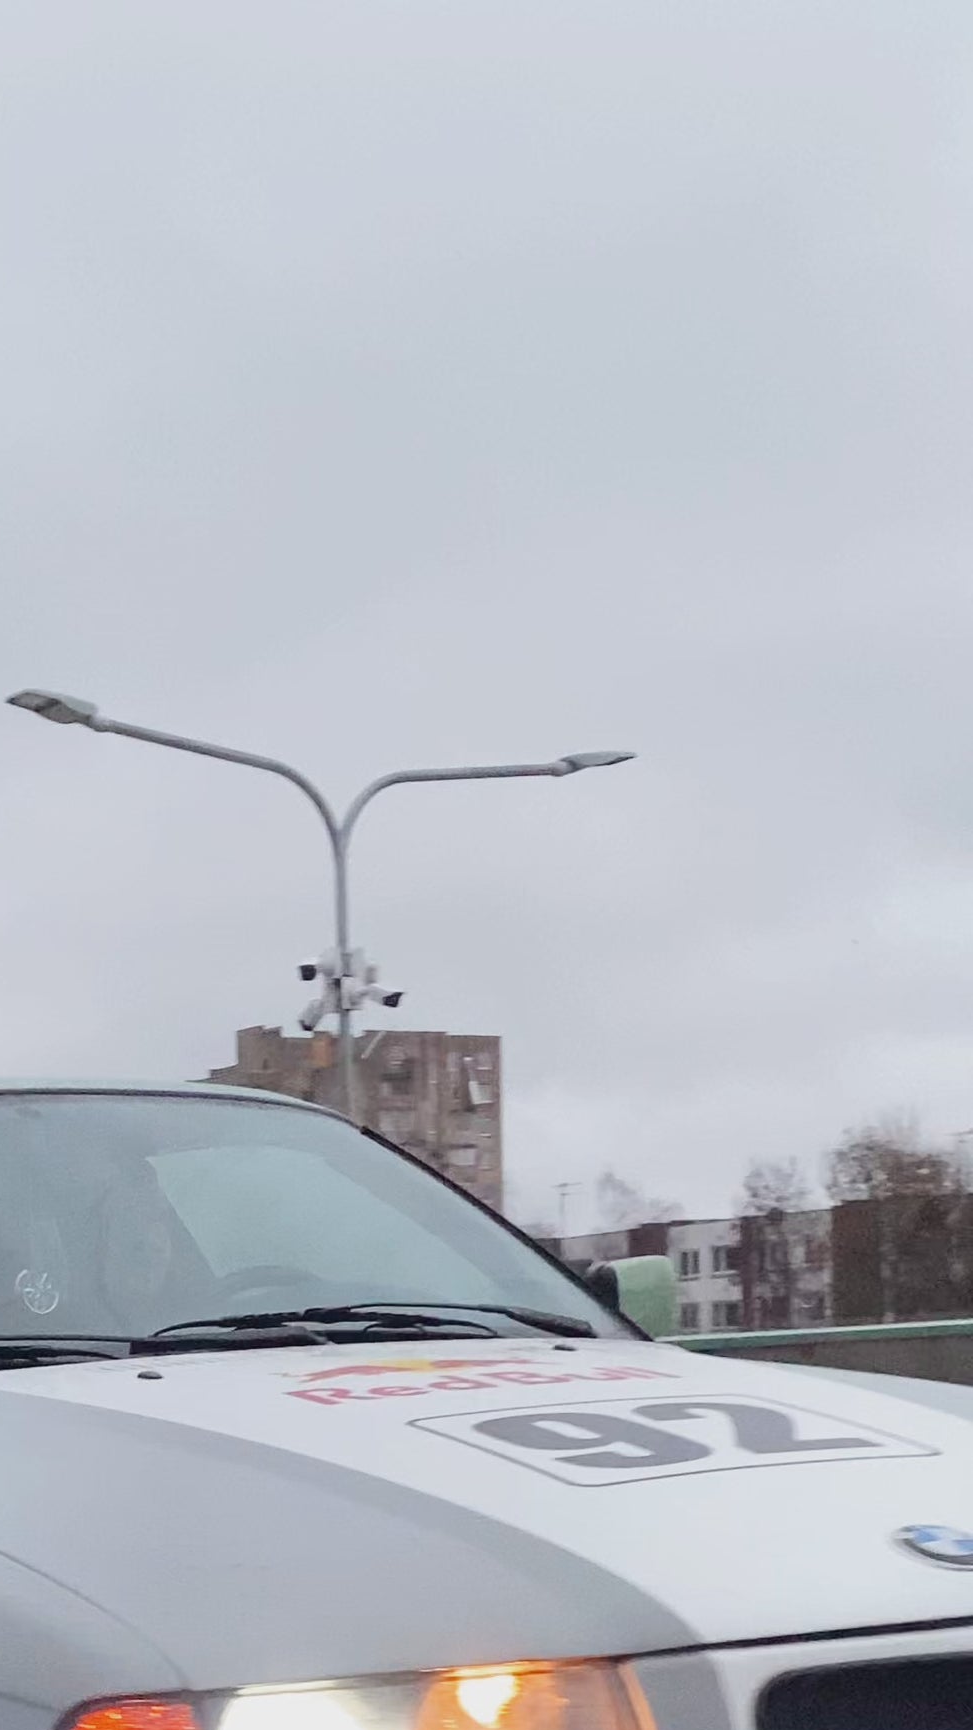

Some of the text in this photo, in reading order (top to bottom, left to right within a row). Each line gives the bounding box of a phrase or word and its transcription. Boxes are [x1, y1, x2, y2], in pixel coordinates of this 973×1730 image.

[285, 1366, 682, 1405] Red Bull
[472, 1402, 882, 1468] 92
